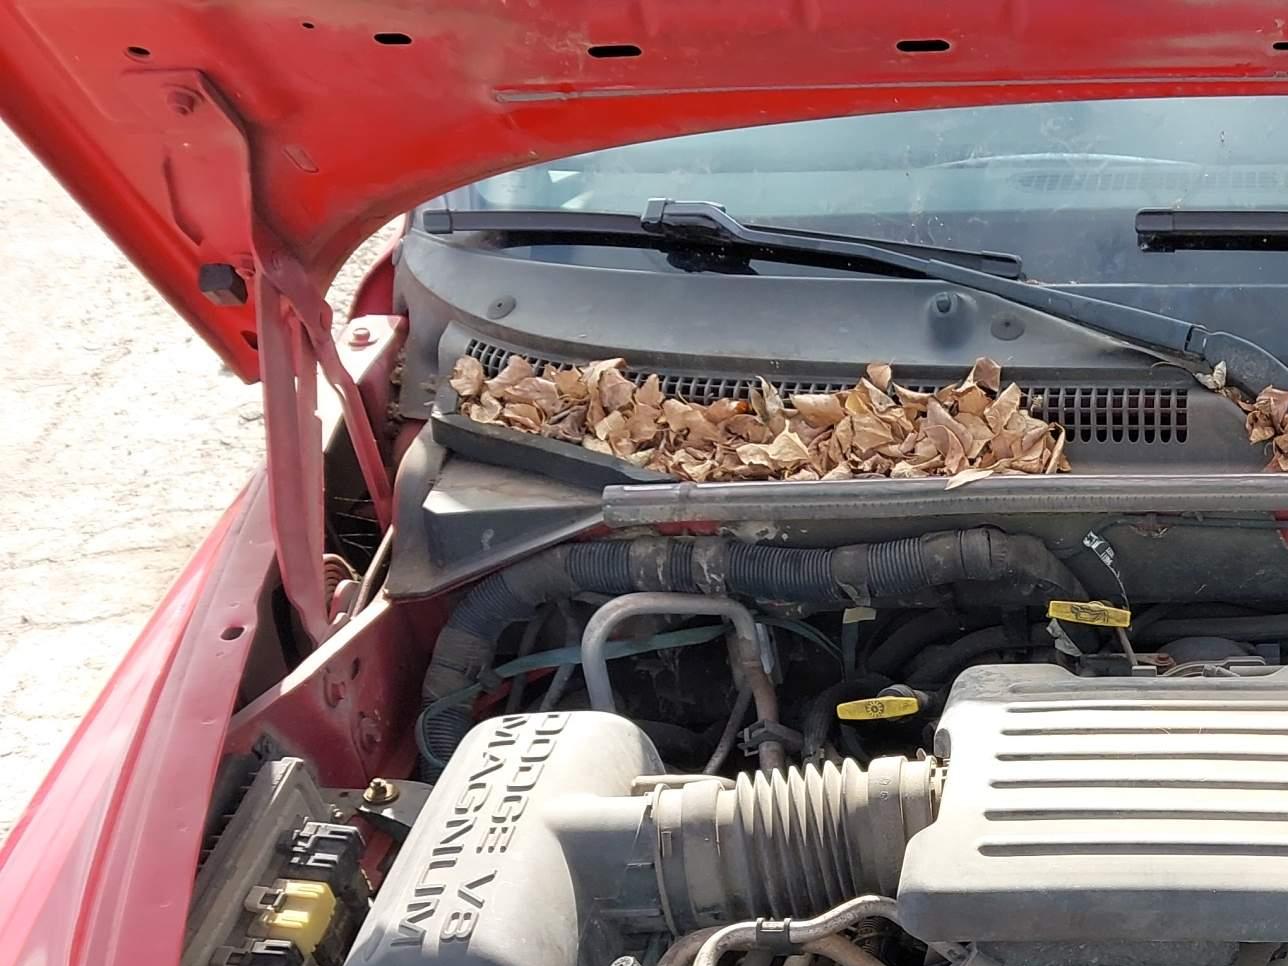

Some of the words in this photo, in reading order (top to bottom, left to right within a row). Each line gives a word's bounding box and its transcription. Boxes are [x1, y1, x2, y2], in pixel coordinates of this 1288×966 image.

[390, 715, 528, 948] MAGNUM
[475, 713, 572, 854] DODGE
[439, 870, 498, 941] V8
